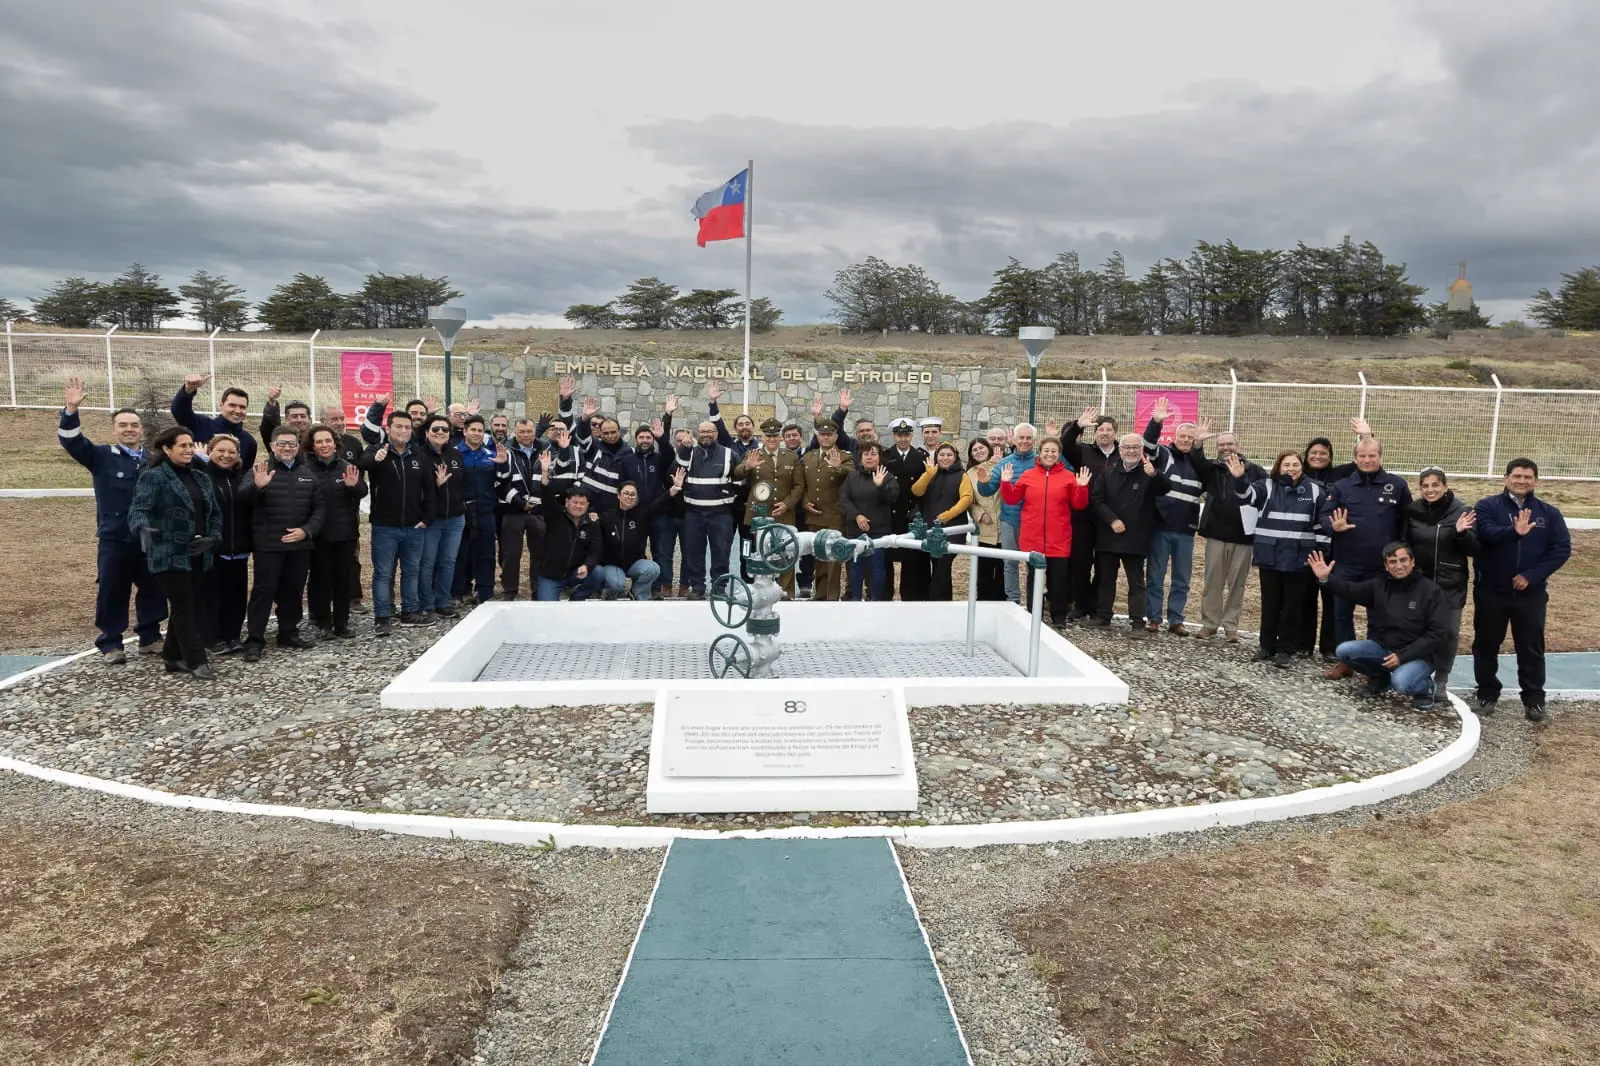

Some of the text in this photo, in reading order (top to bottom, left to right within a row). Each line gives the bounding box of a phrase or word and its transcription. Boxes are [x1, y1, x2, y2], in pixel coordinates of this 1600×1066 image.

[554, 360, 650, 377] EMPRESA
[780, 368, 817, 381] DEL
[831, 370, 932, 384] PETROLEO
